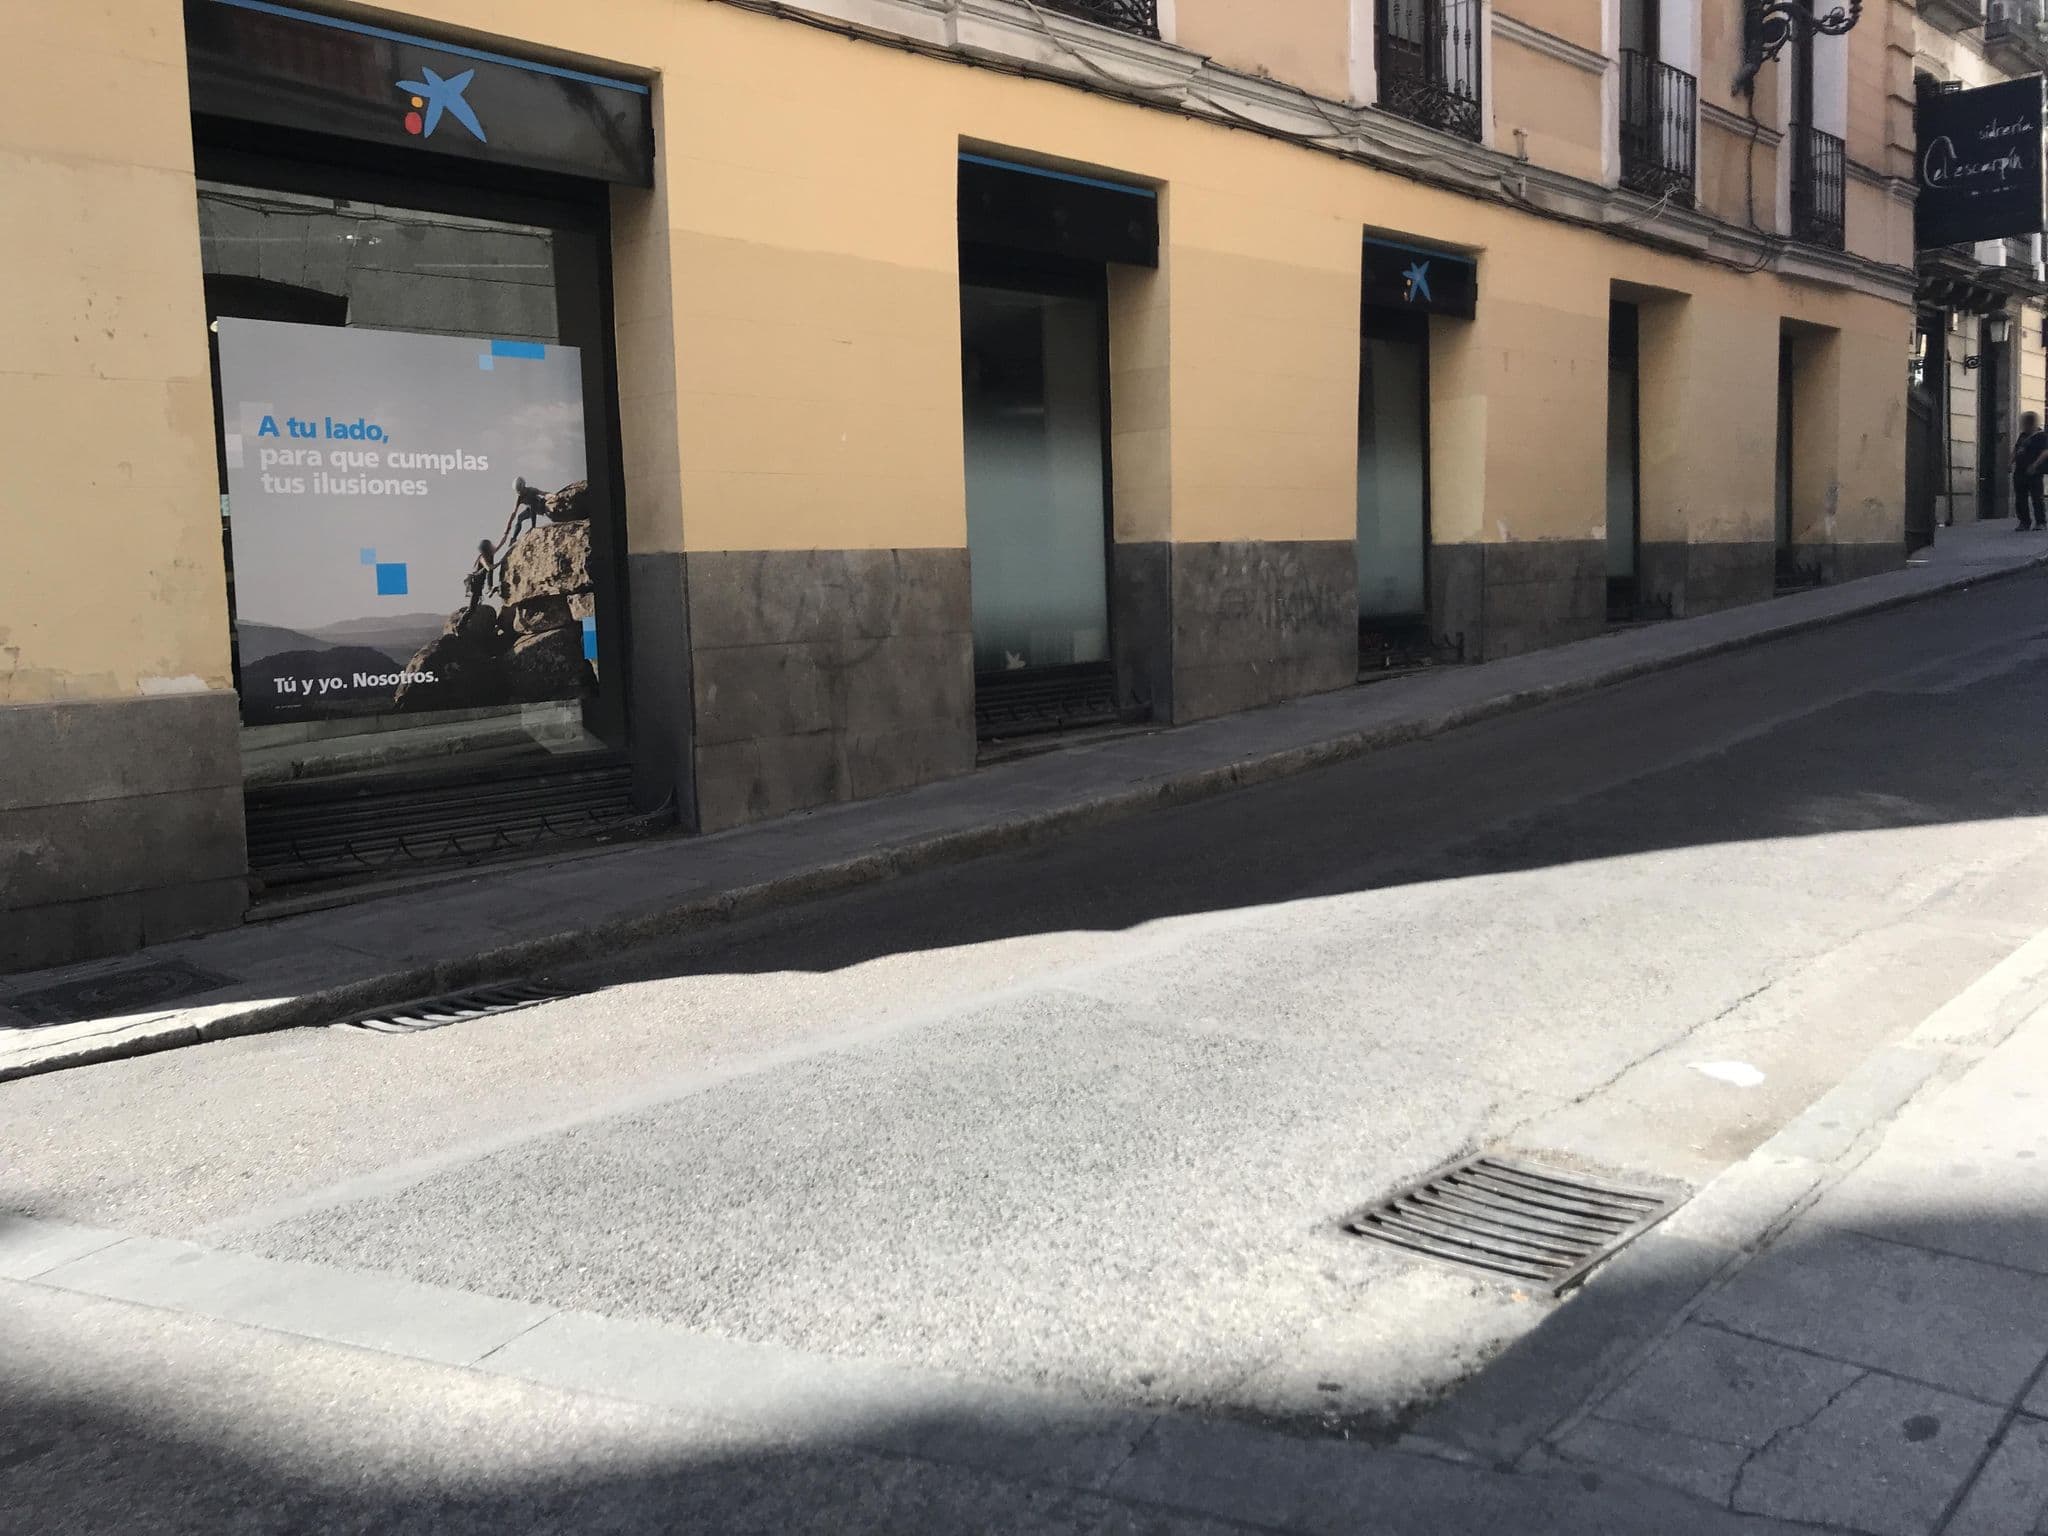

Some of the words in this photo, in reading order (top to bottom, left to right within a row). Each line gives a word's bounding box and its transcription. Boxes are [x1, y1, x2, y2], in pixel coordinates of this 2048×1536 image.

[258, 415, 280, 437] A
[286, 417, 317, 439] tu
[325, 416, 389, 444] lado,
[260, 448, 323, 471] para
[330, 450, 380, 473] que
[387, 449, 489, 475] cumplas
[260, 473, 305, 494] tus
[313, 472, 428, 496] ilusiones
[273, 676, 297, 694] Tú
[302, 678, 314, 696] y
[318, 677, 348, 696] yo.
[352, 671, 439, 689] Nosotros.
